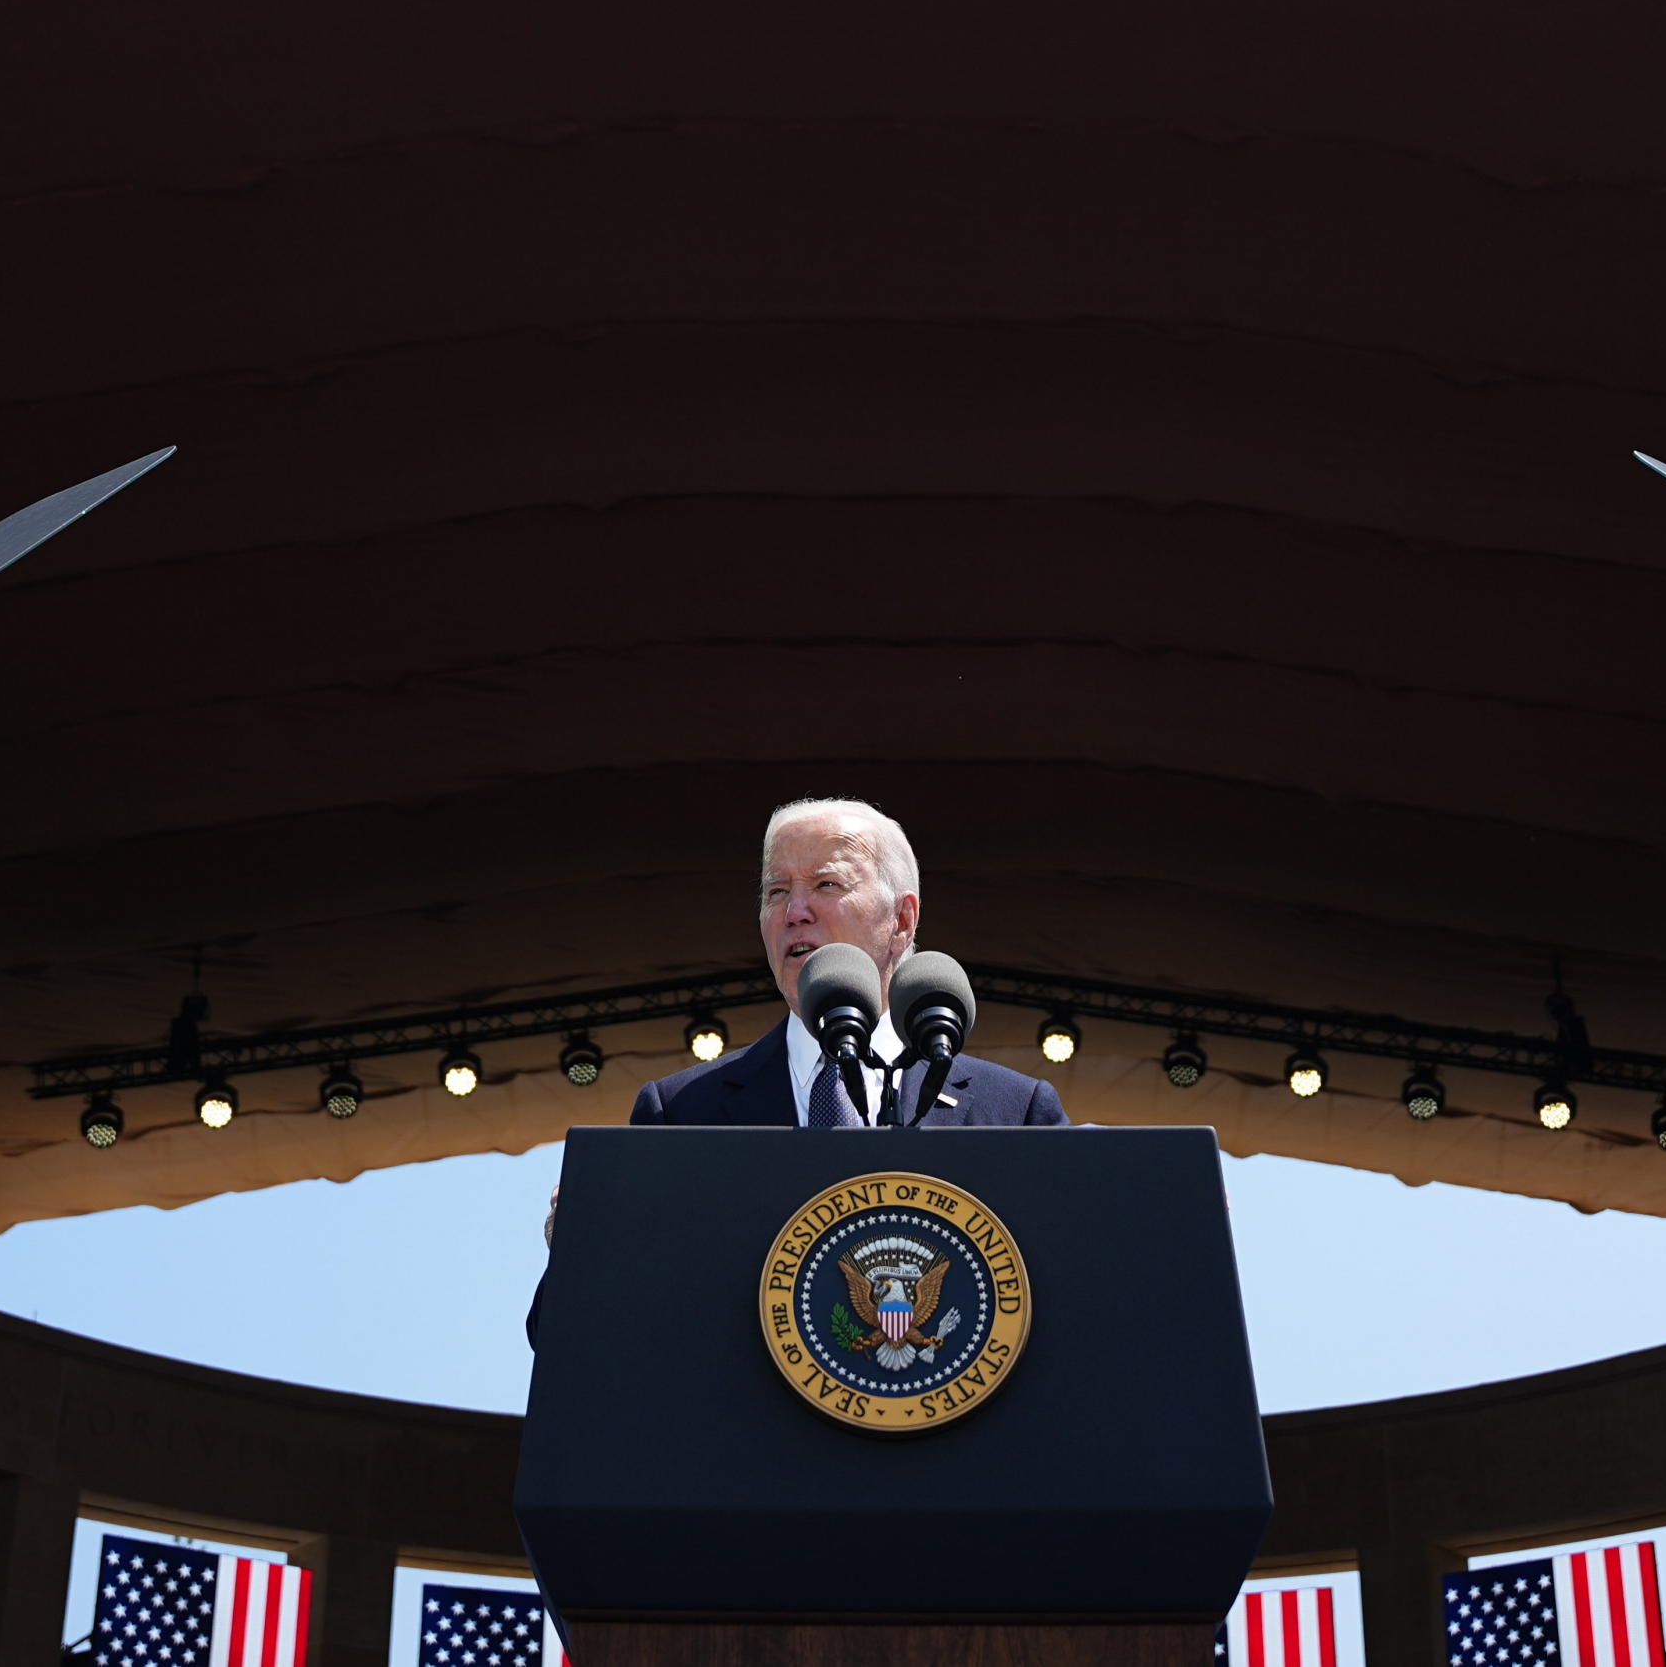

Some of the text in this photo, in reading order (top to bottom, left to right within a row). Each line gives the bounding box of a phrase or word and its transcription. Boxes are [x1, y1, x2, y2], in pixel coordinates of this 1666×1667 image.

[769, 1182, 1021, 1418] SEAL OF THE PRESIDENT OF THE UNITED STATES
